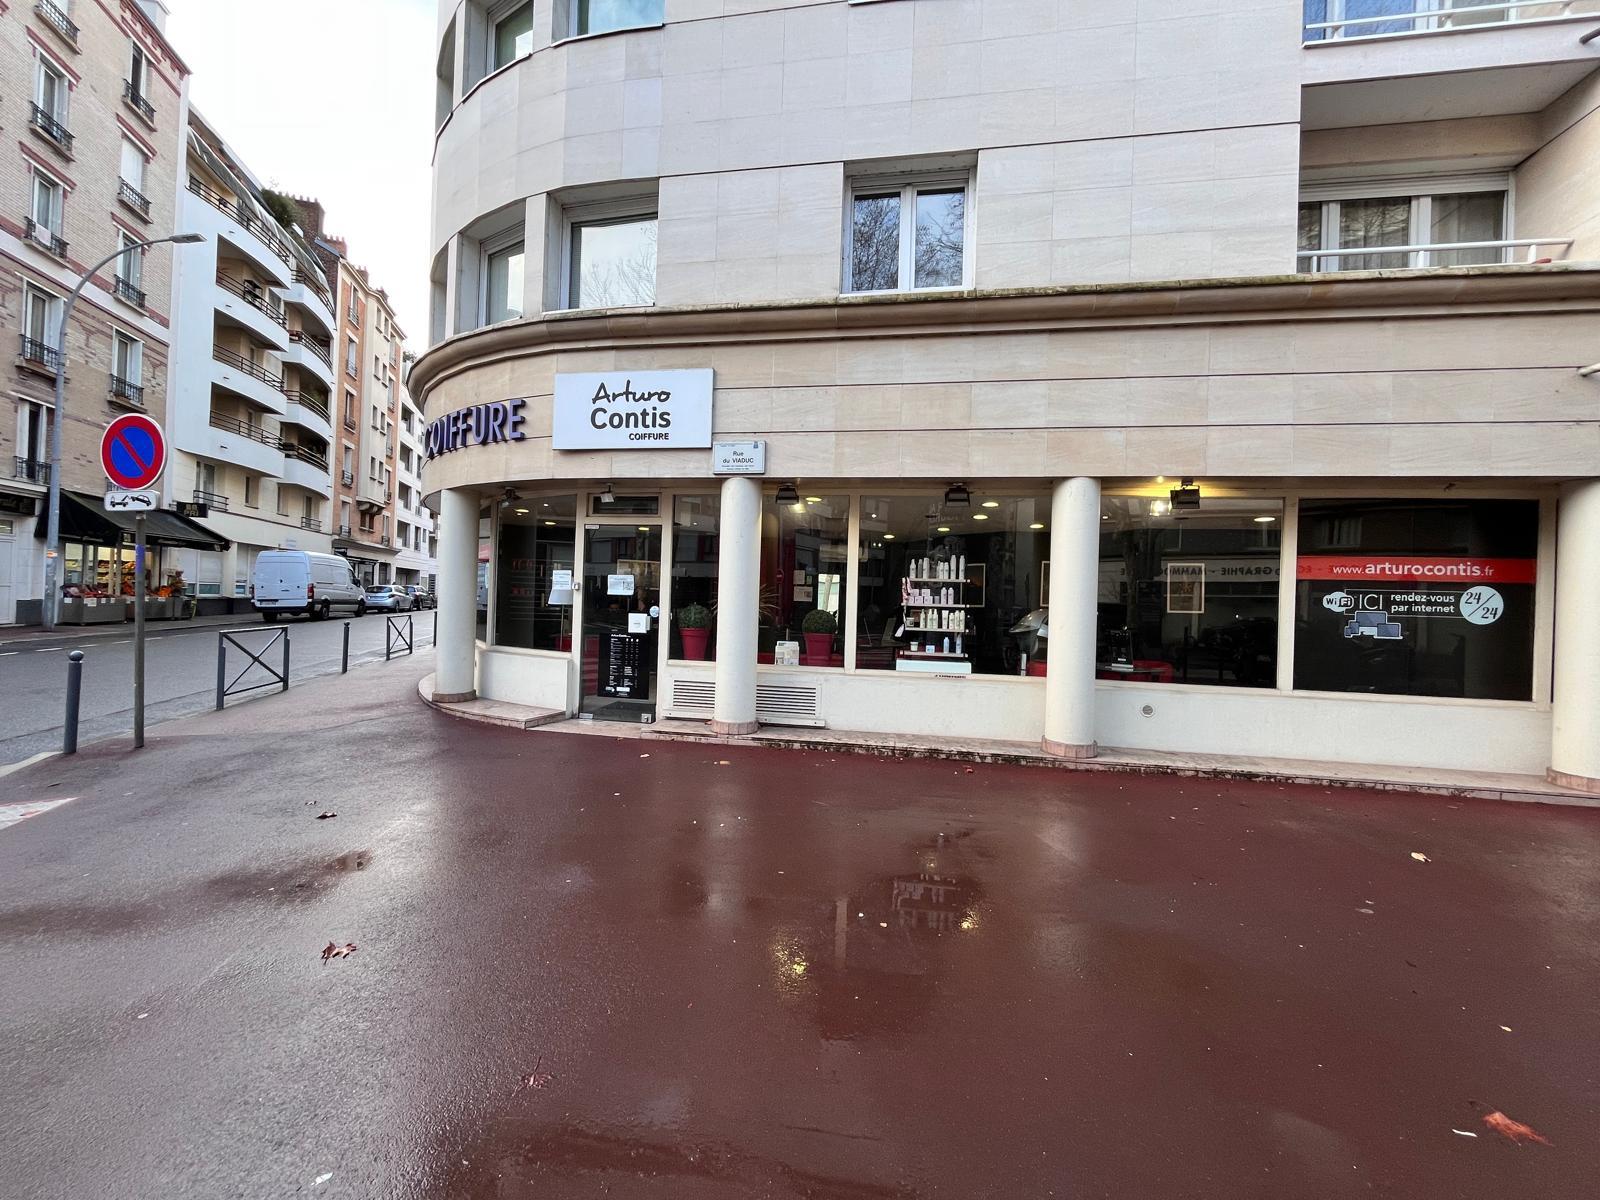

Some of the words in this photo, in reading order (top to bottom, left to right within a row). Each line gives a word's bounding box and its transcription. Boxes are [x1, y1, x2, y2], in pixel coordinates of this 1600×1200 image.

[592, 379, 671, 404] Arturo
[590, 406, 671, 429] Contis
[424, 398, 527, 461] COIFFURE
[628, 432, 670, 441] COIFFURE
[1333, 561, 1495, 578] www.arturocontis.fr
[1359, 594, 1383, 610] ICI
[1390, 592, 1455, 604] rendez-vous
[1391, 604, 1410, 614] par
[1411, 603, 1455, 614] internet
